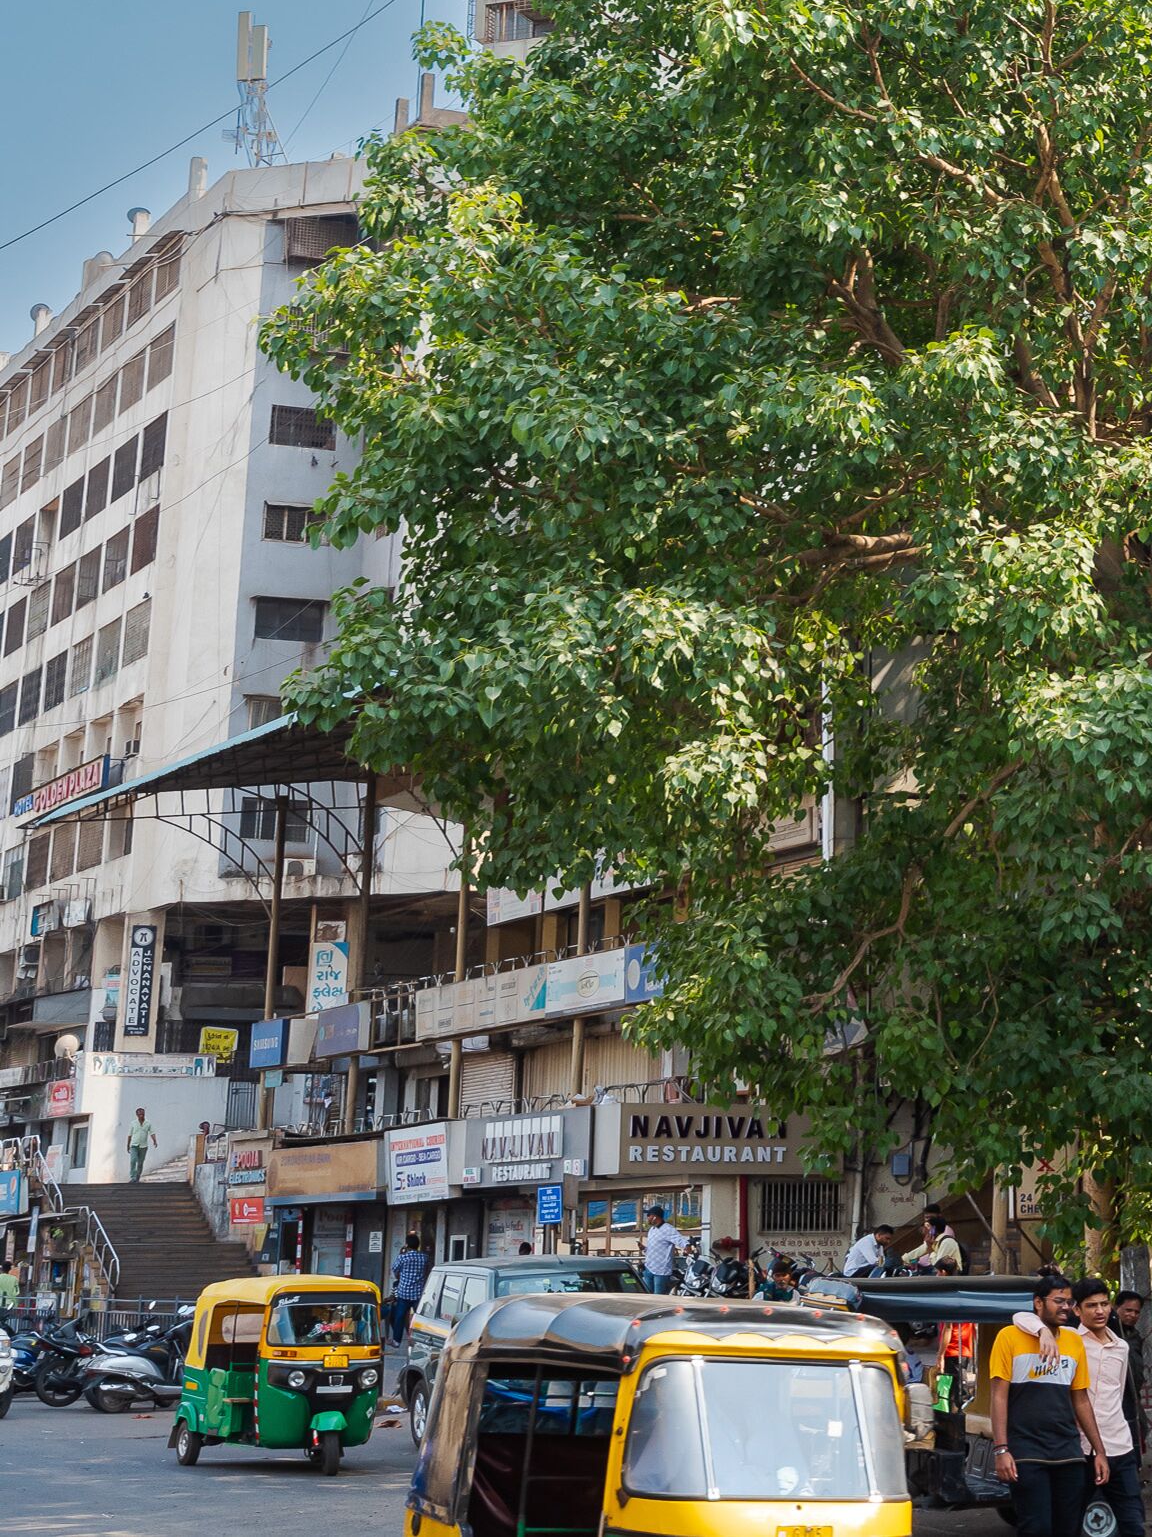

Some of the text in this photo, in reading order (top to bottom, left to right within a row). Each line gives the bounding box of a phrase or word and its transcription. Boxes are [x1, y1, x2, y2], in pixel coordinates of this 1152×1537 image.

[33, 775, 70, 812] GOLDEN
[69, 763, 100, 794] PLAZA
[128, 950, 141, 1023] ADVOCATE
[254, 1037, 278, 1050] SAMSUNG
[630, 1115, 787, 1139] NAVJIVAN
[482, 1131, 560, 1160] NAVJIVAN
[629, 1145, 787, 1162] RESTAURANT
[229, 1169, 265, 1183] ELECTRONICS
[492, 1163, 551, 1182] RESTAURANT
[1020, 1193, 1032, 1203] 24
